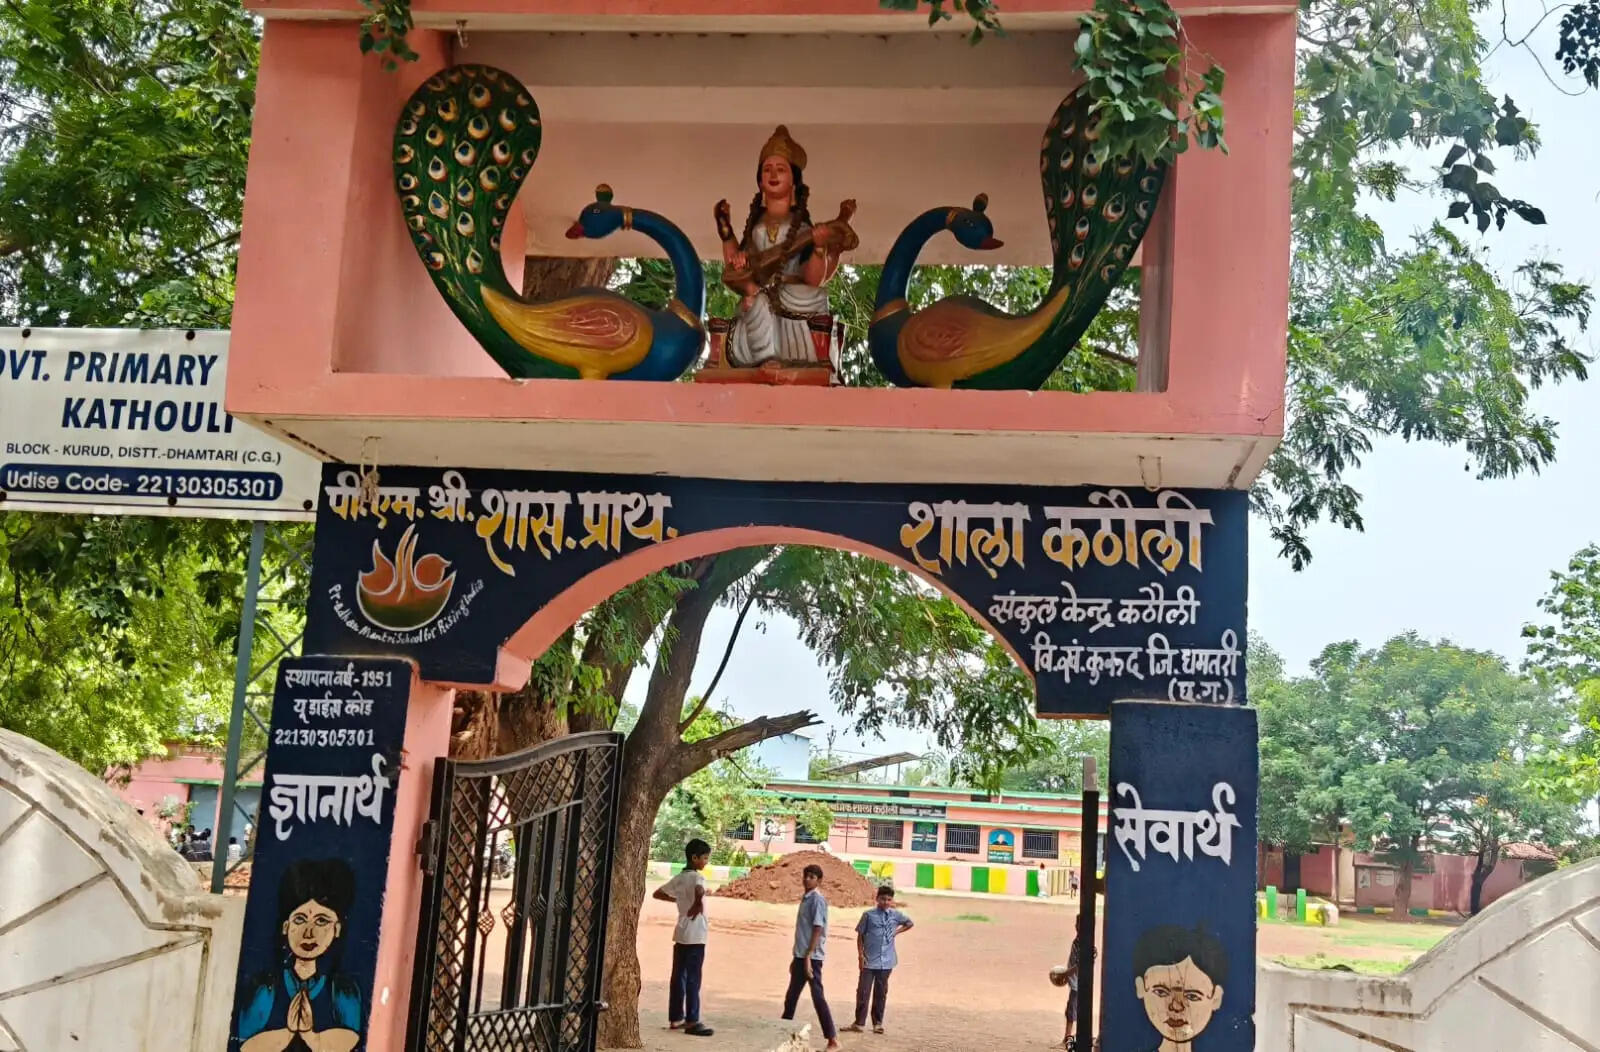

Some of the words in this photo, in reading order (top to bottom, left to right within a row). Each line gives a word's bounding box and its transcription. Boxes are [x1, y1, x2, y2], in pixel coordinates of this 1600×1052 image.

[0, 348, 50, 381] VT.
[64, 351, 218, 386] PRIMARY
[62, 397, 234, 433] KATHOULI
[6, 442, 50, 455] BLOCK
[62, 445, 114, 459] KURUD,
[242, 451, 282, 466] (C.G.)
[6, 470, 59, 490] Udise
[136, 474, 277, 498] 22130305301
[900, 499, 1032, 579] शाला
[1042, 488, 1215, 576] कठौली
[988, 590, 1060, 635] संकुल
[1061, 580, 1115, 634] केन्द्र
[1117, 582, 1201, 625] कठौली
[1181, 628, 1242, 677] धमतरी
[284, 669, 334, 689] स्थापना
[344, 690, 374, 717] कोड
[274, 728, 375, 747] 22130305301
[269, 752, 391, 842] ज्ञानार्थ
[1112, 781, 1243, 872] सेवार्थ
